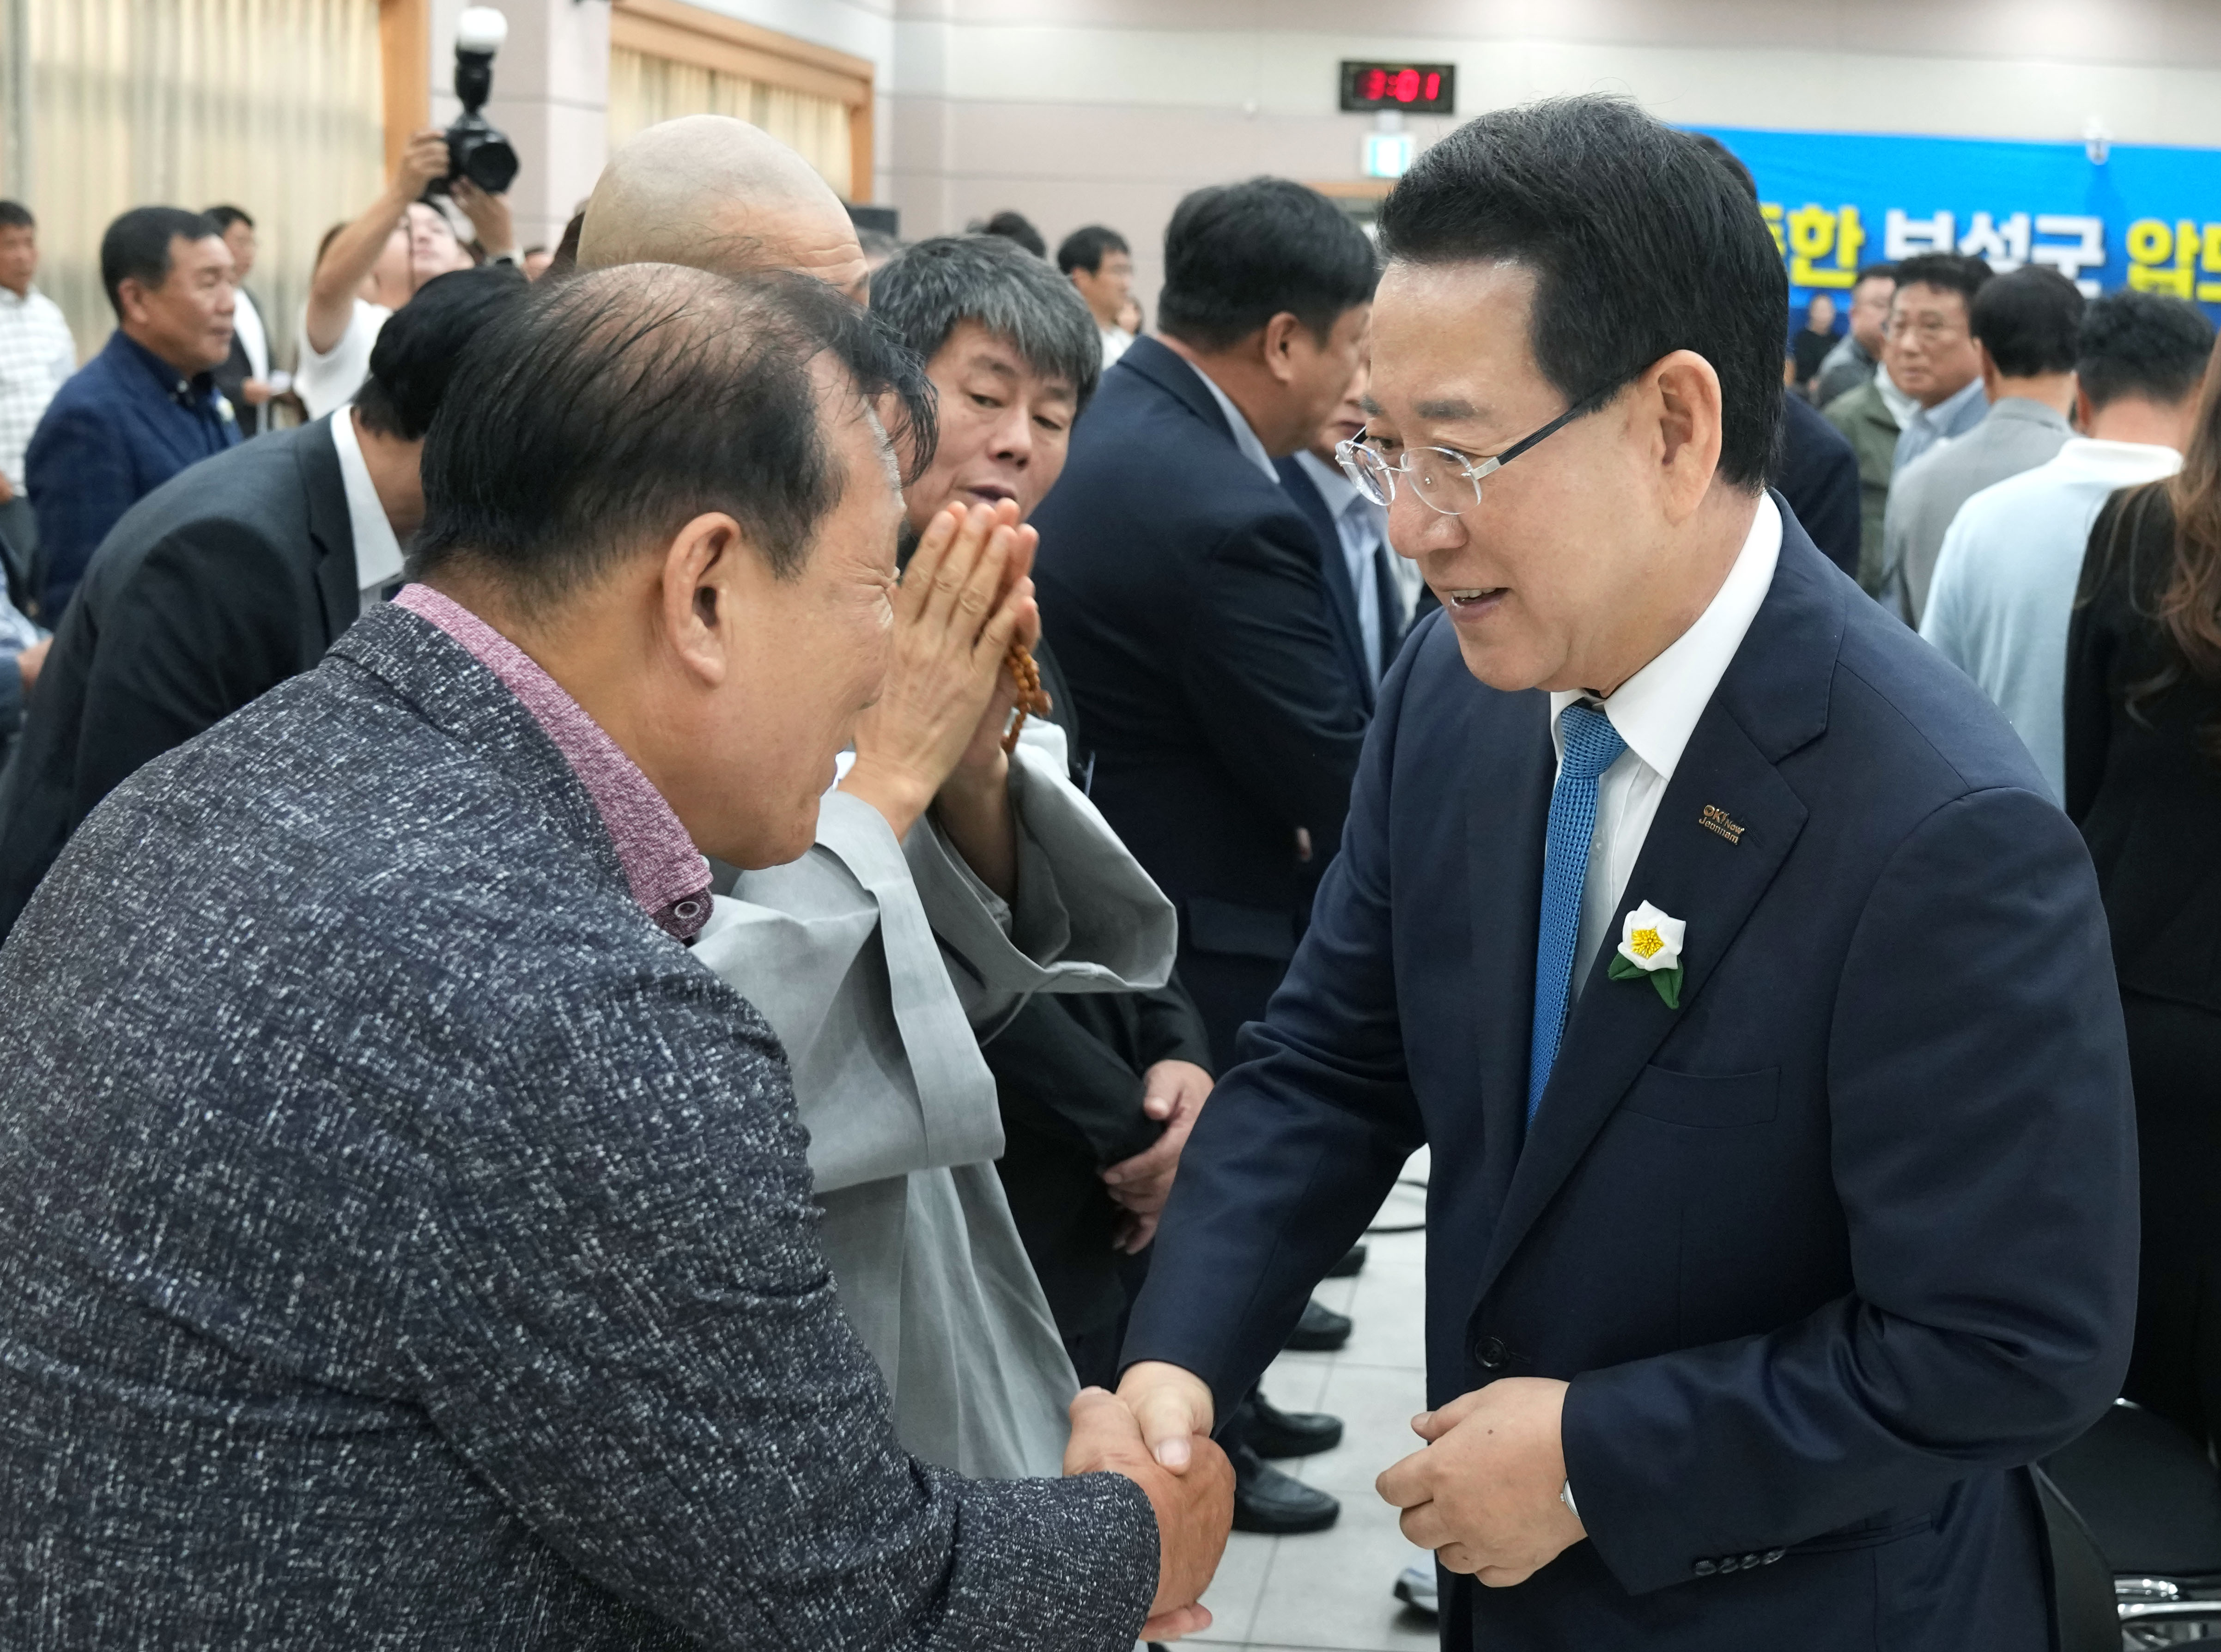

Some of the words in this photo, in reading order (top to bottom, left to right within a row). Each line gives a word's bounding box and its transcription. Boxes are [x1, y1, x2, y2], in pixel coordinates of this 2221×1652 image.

[1366, 69, 1440, 102] 3:01
[1759, 202, 1865, 288] 한
[1699, 817, 1738, 845] Jeonnam
[1724, 819, 1745, 834] Now
